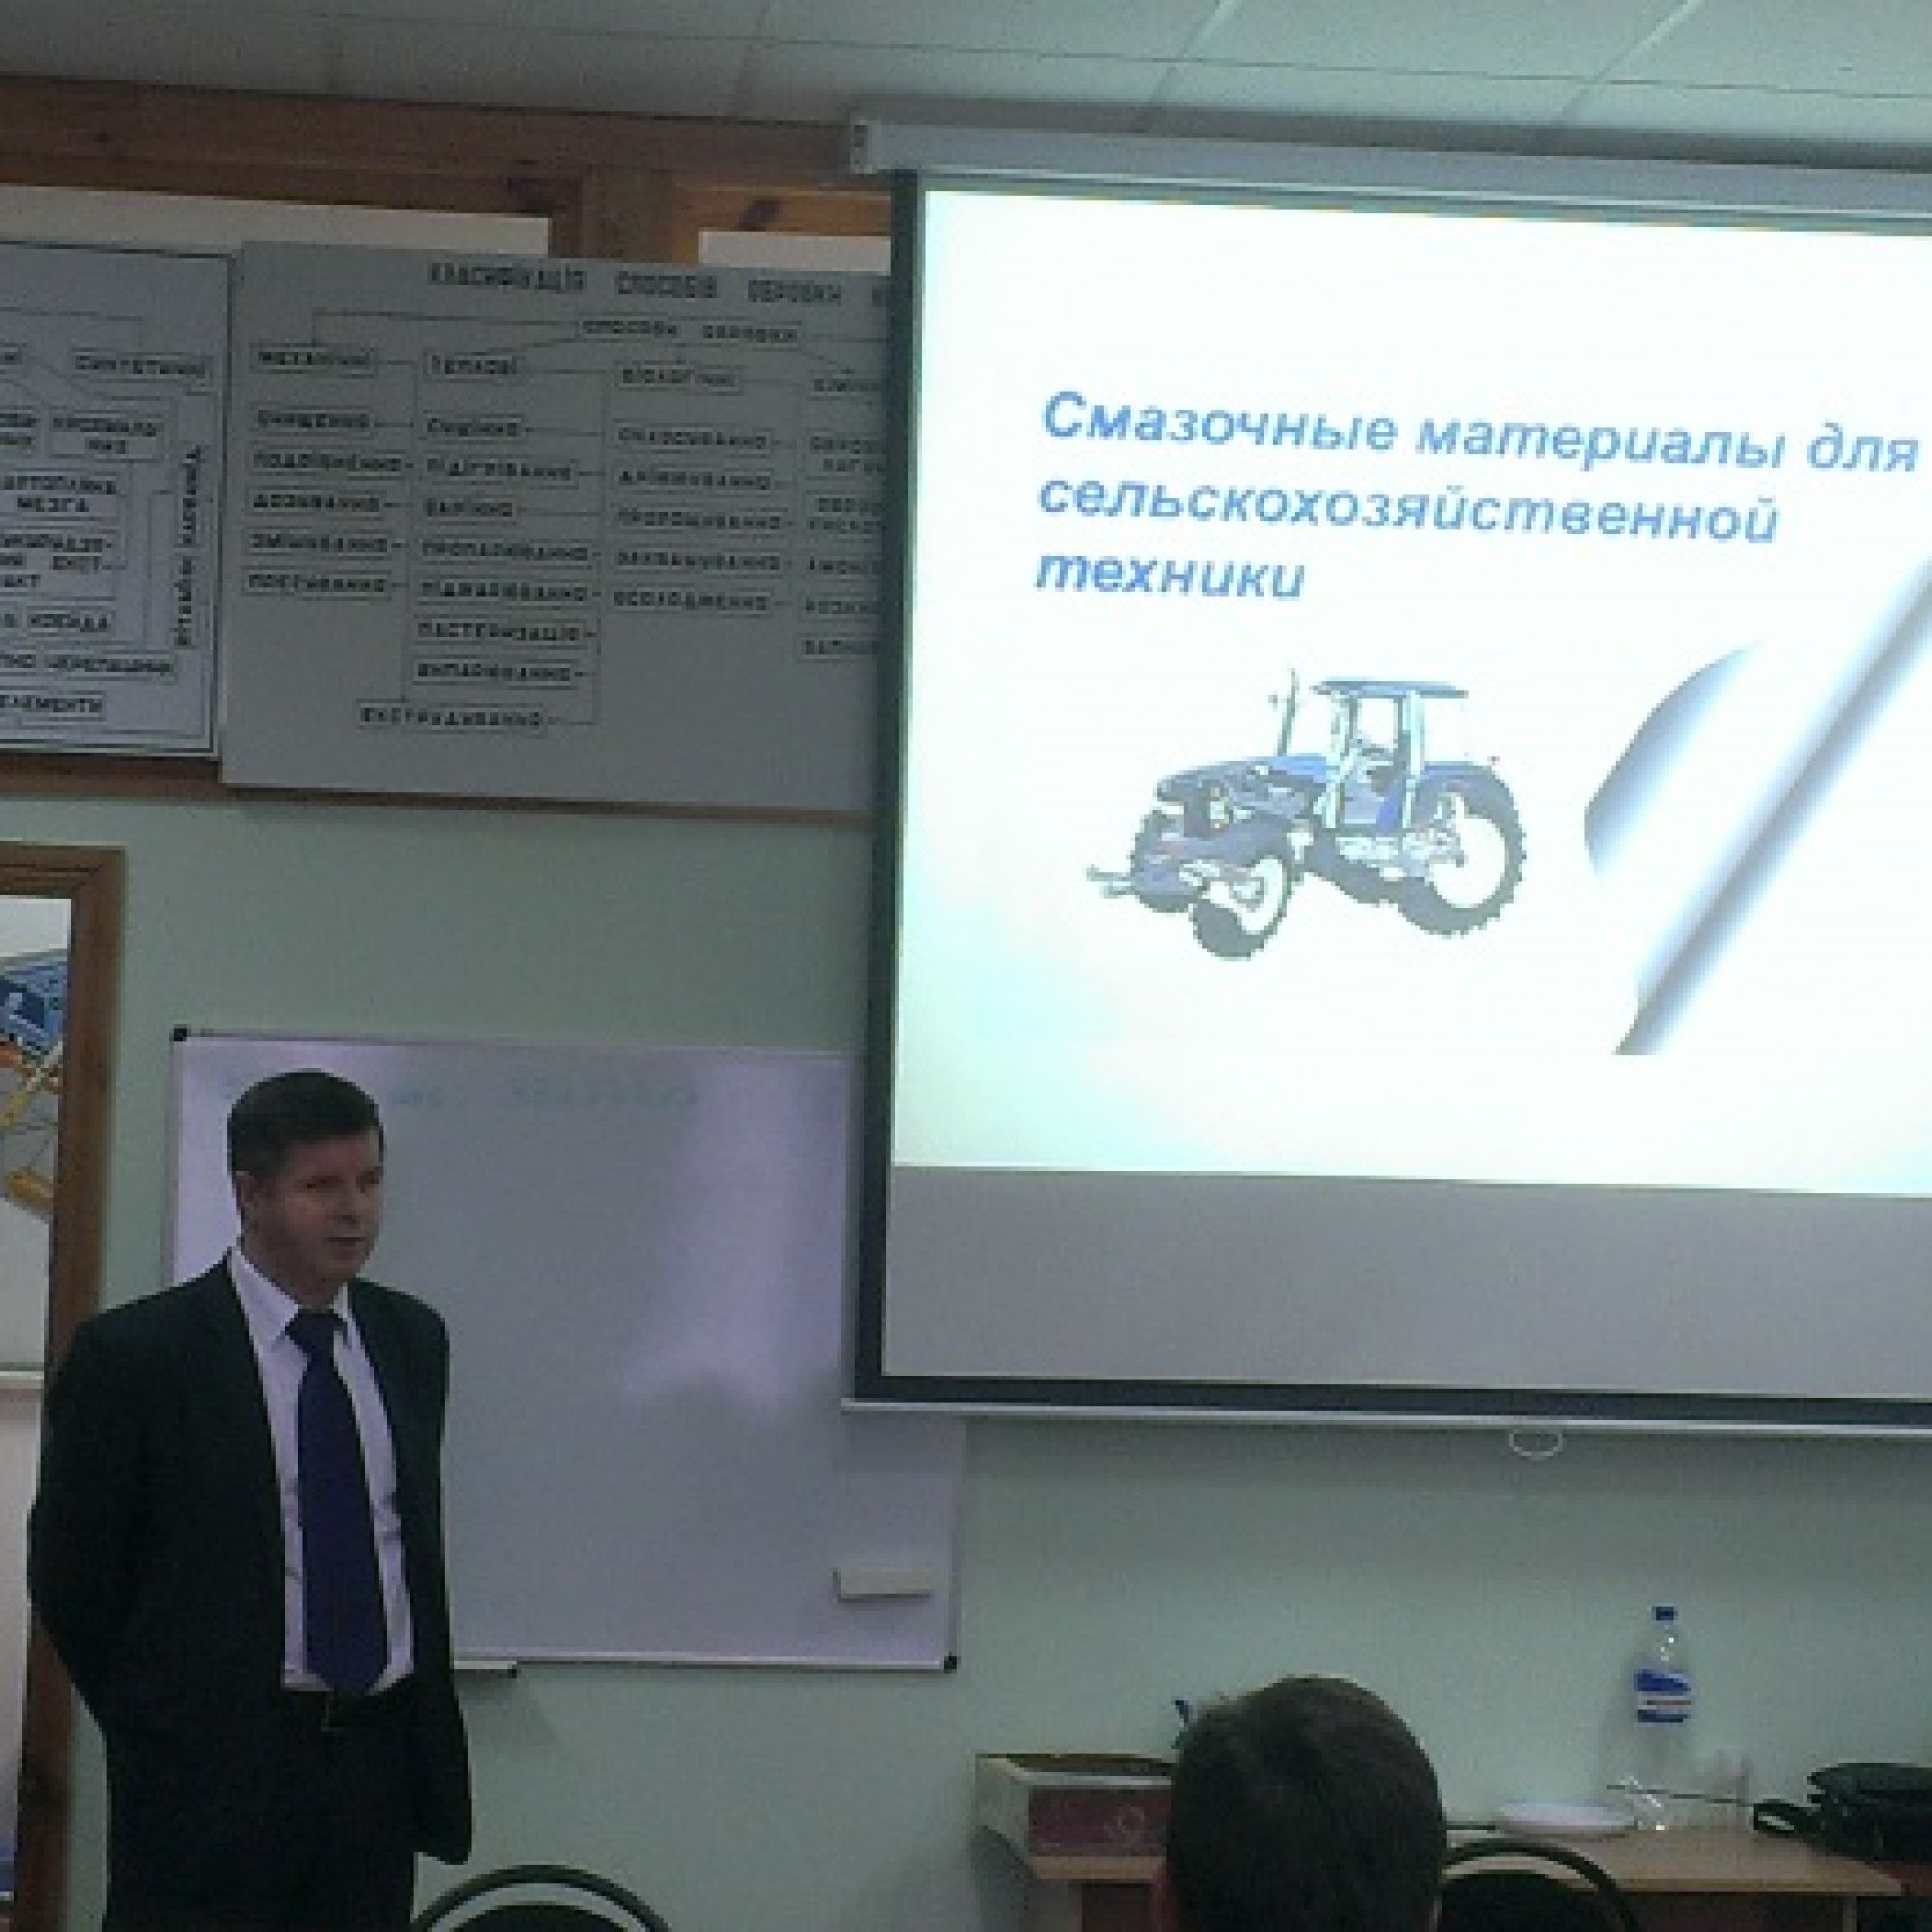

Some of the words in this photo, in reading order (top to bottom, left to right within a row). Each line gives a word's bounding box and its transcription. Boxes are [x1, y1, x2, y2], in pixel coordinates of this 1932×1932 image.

[1042, 390, 1398, 452] Смазочные
[1416, 412, 1786, 472] материалы
[1806, 421, 1919, 473] для
[1039, 477, 1779, 544] сельскохозяйственной
[1035, 553, 1306, 599] техники
